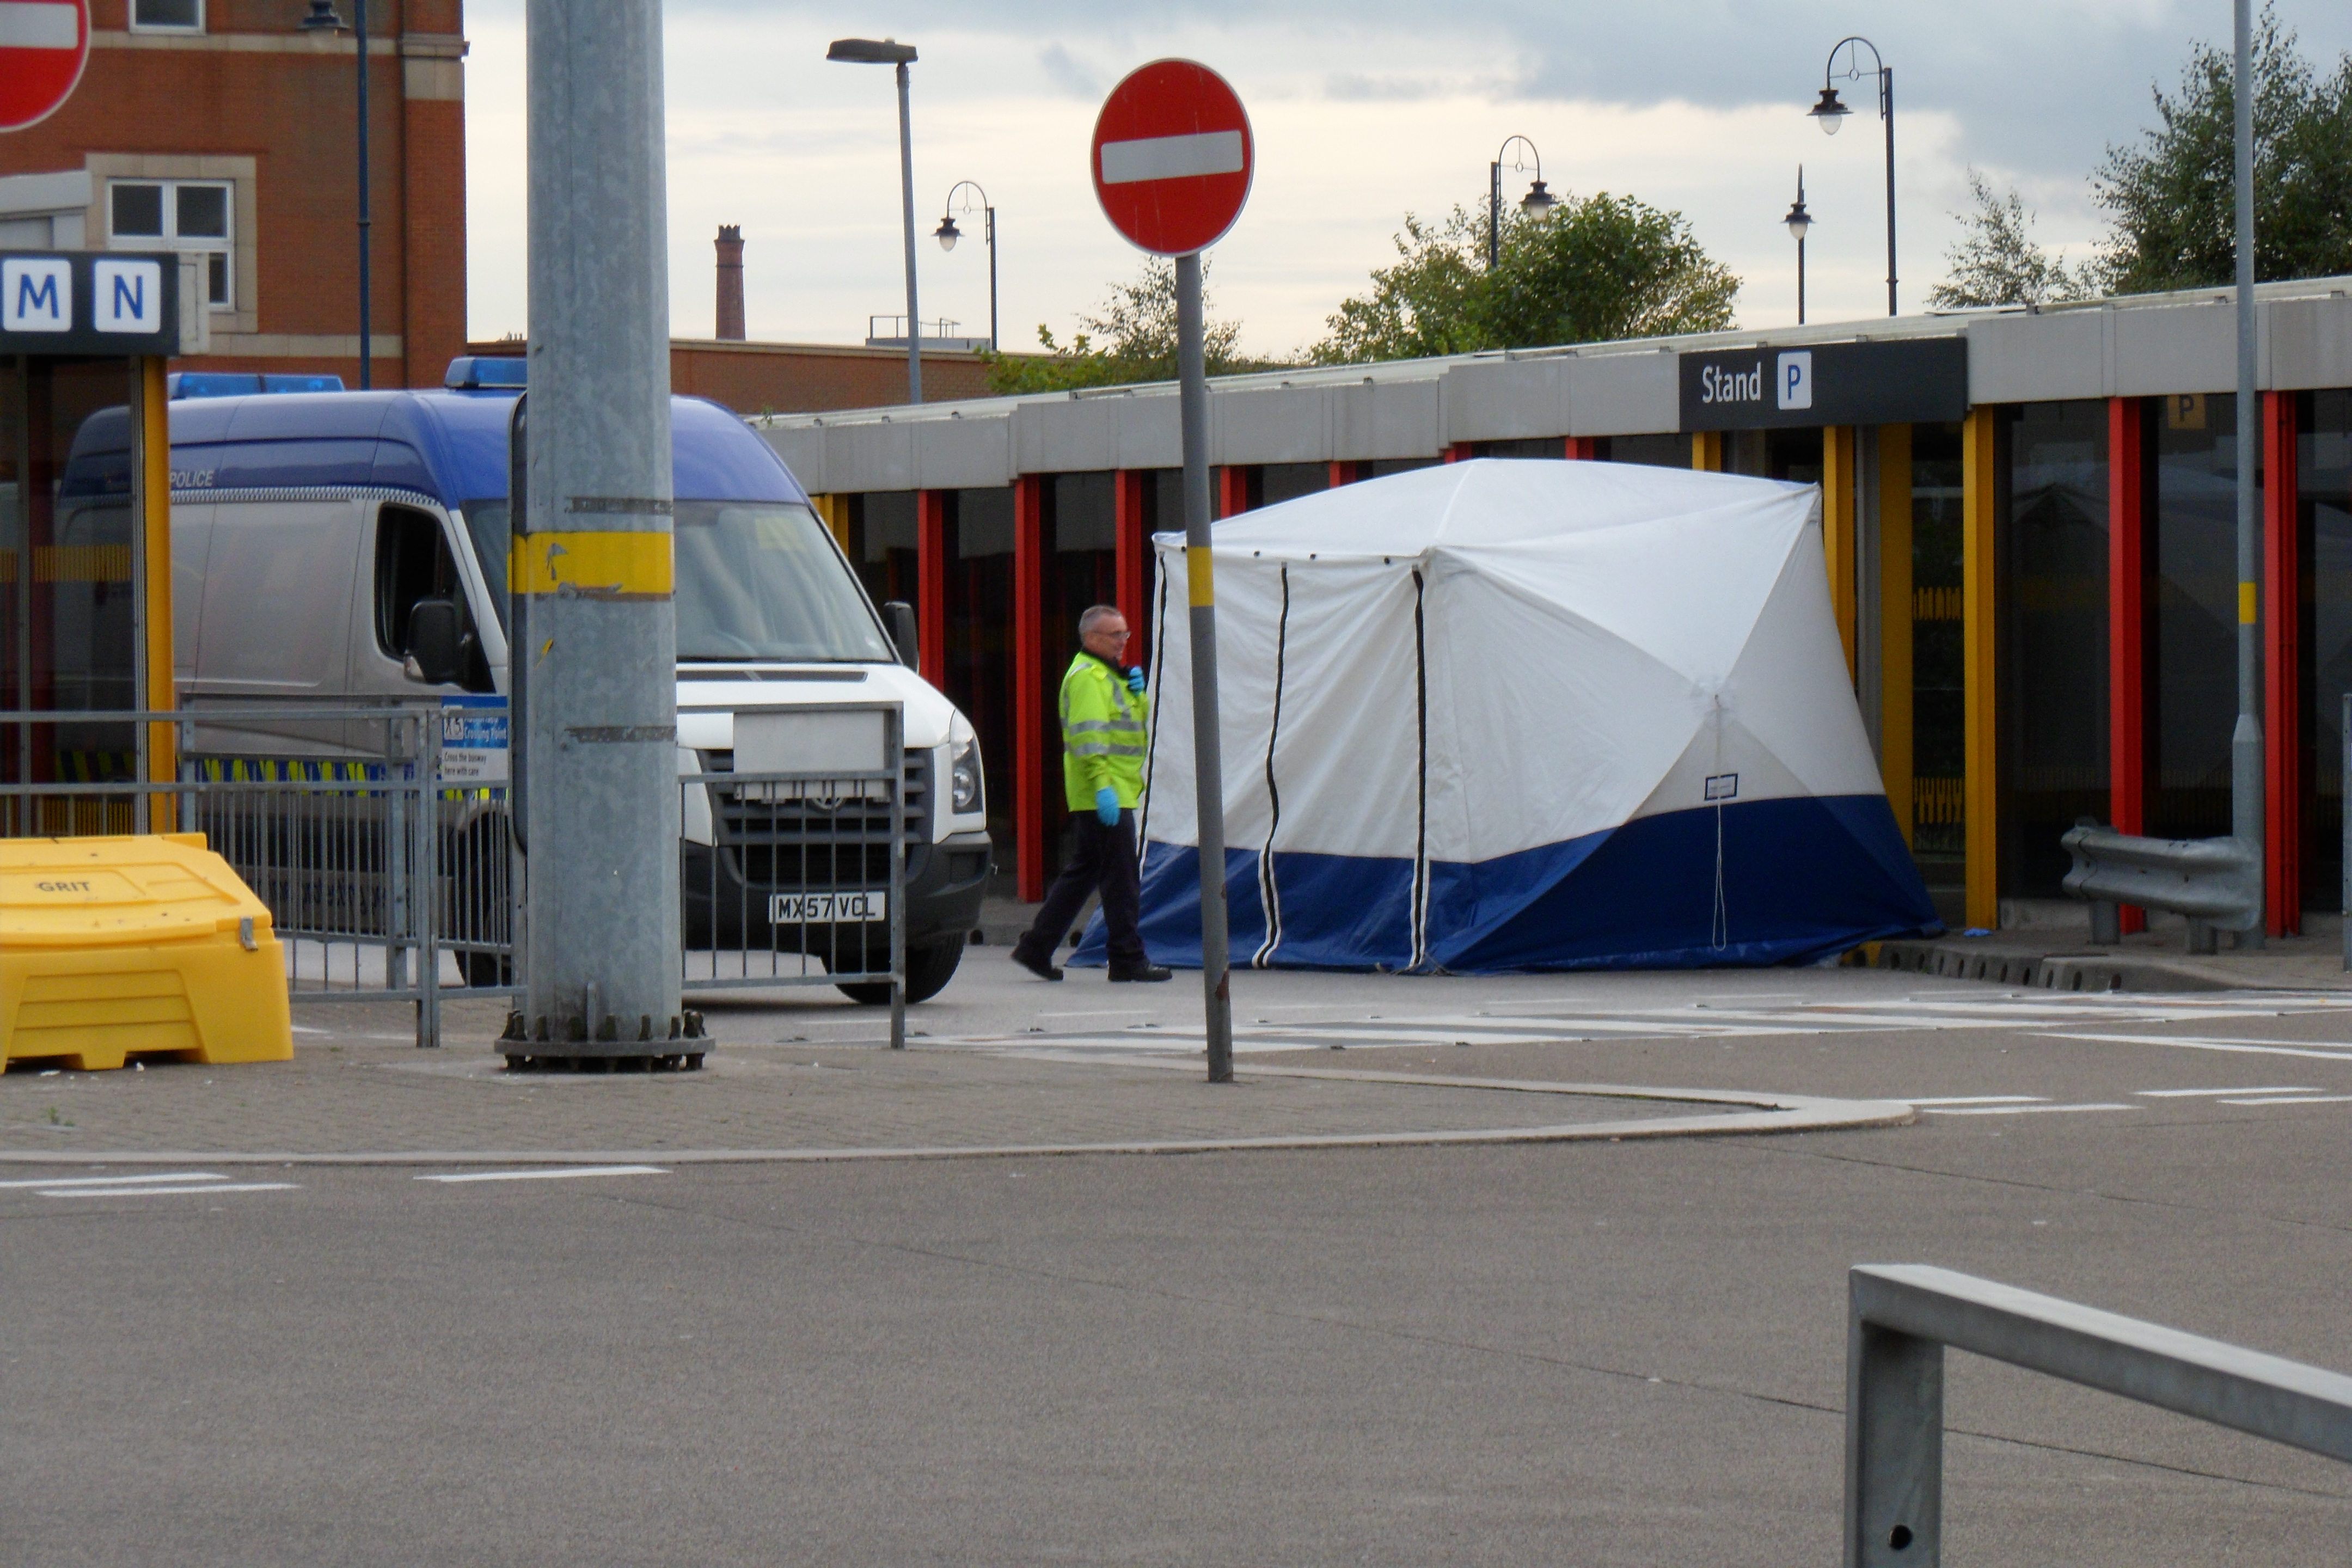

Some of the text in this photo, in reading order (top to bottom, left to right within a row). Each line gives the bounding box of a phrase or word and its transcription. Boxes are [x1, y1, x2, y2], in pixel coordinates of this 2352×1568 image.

[17, 274, 143, 320] M N
[1701, 362, 1801, 403] Stand P
[2179, 395, 2194, 421] P
[170, 469, 215, 488] POLICE
[38, 881, 89, 891] GRIT
